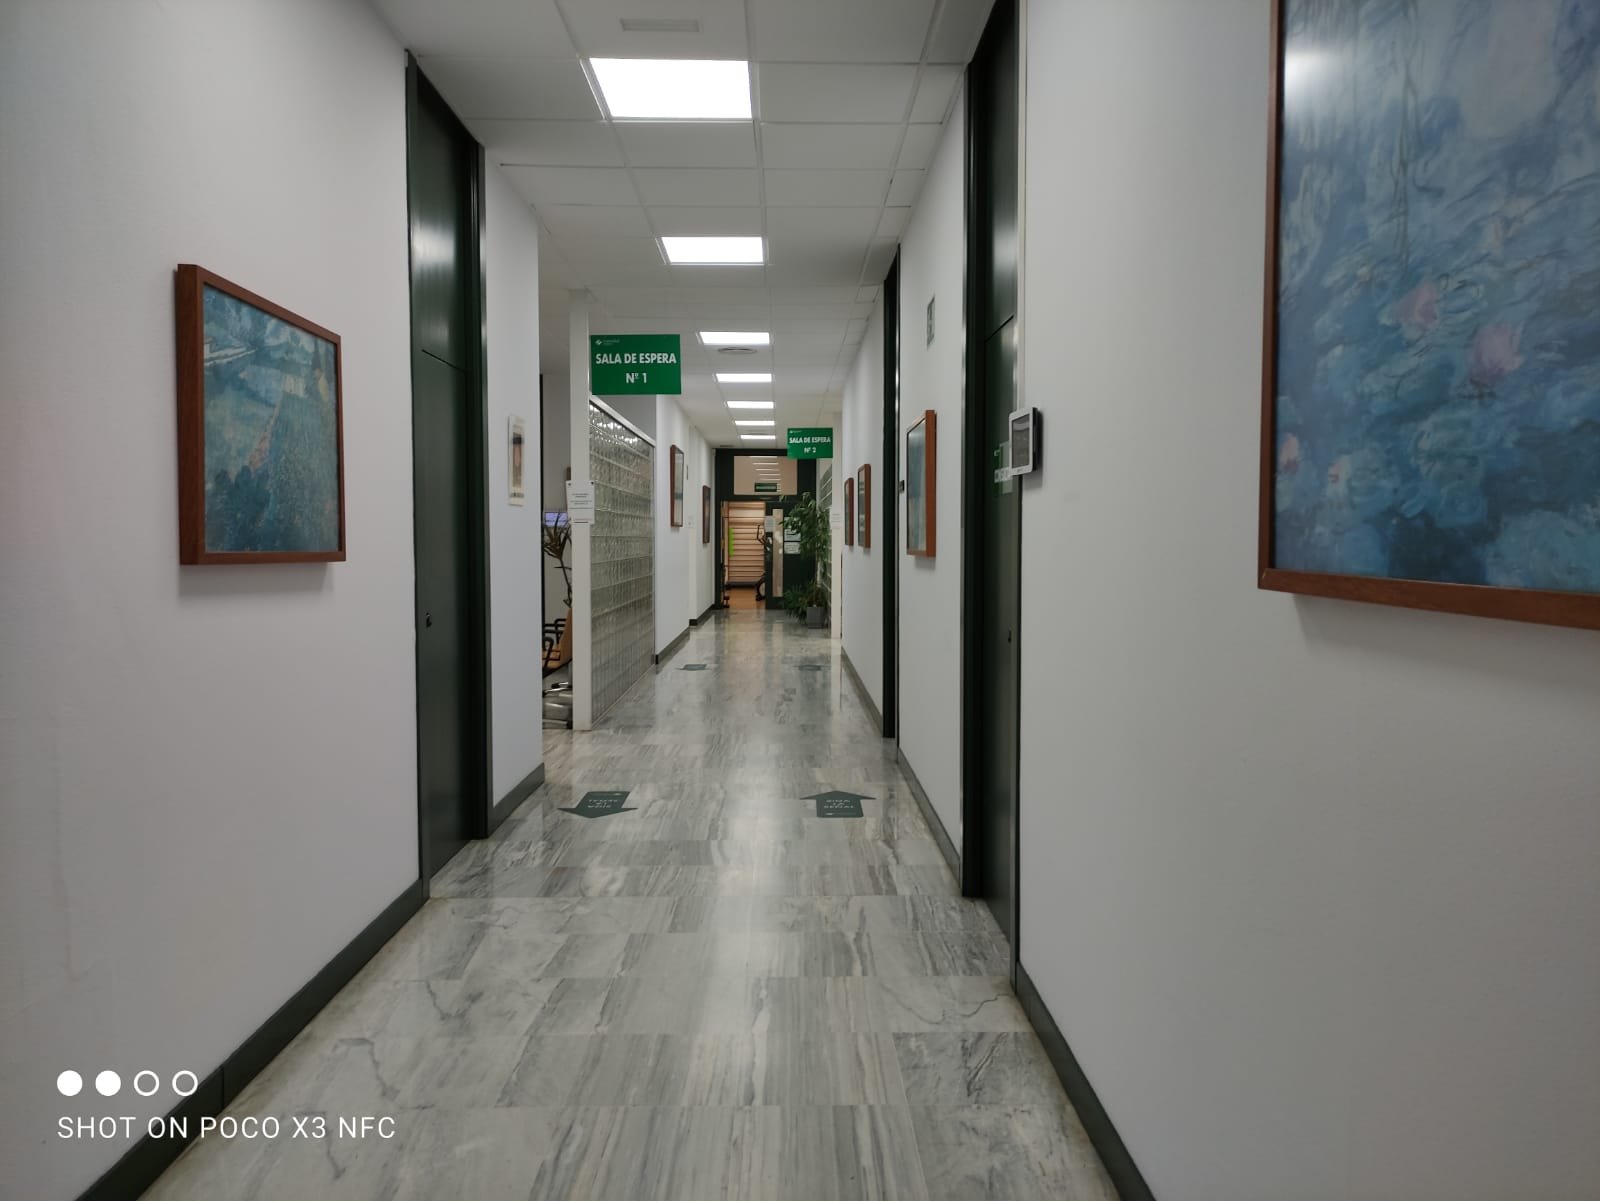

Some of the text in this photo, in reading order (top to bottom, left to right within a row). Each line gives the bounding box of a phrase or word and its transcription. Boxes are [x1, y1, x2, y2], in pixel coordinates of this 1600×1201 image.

[595, 352, 677, 364] SALA DE ESPERA
[642, 372, 647, 384] 1
